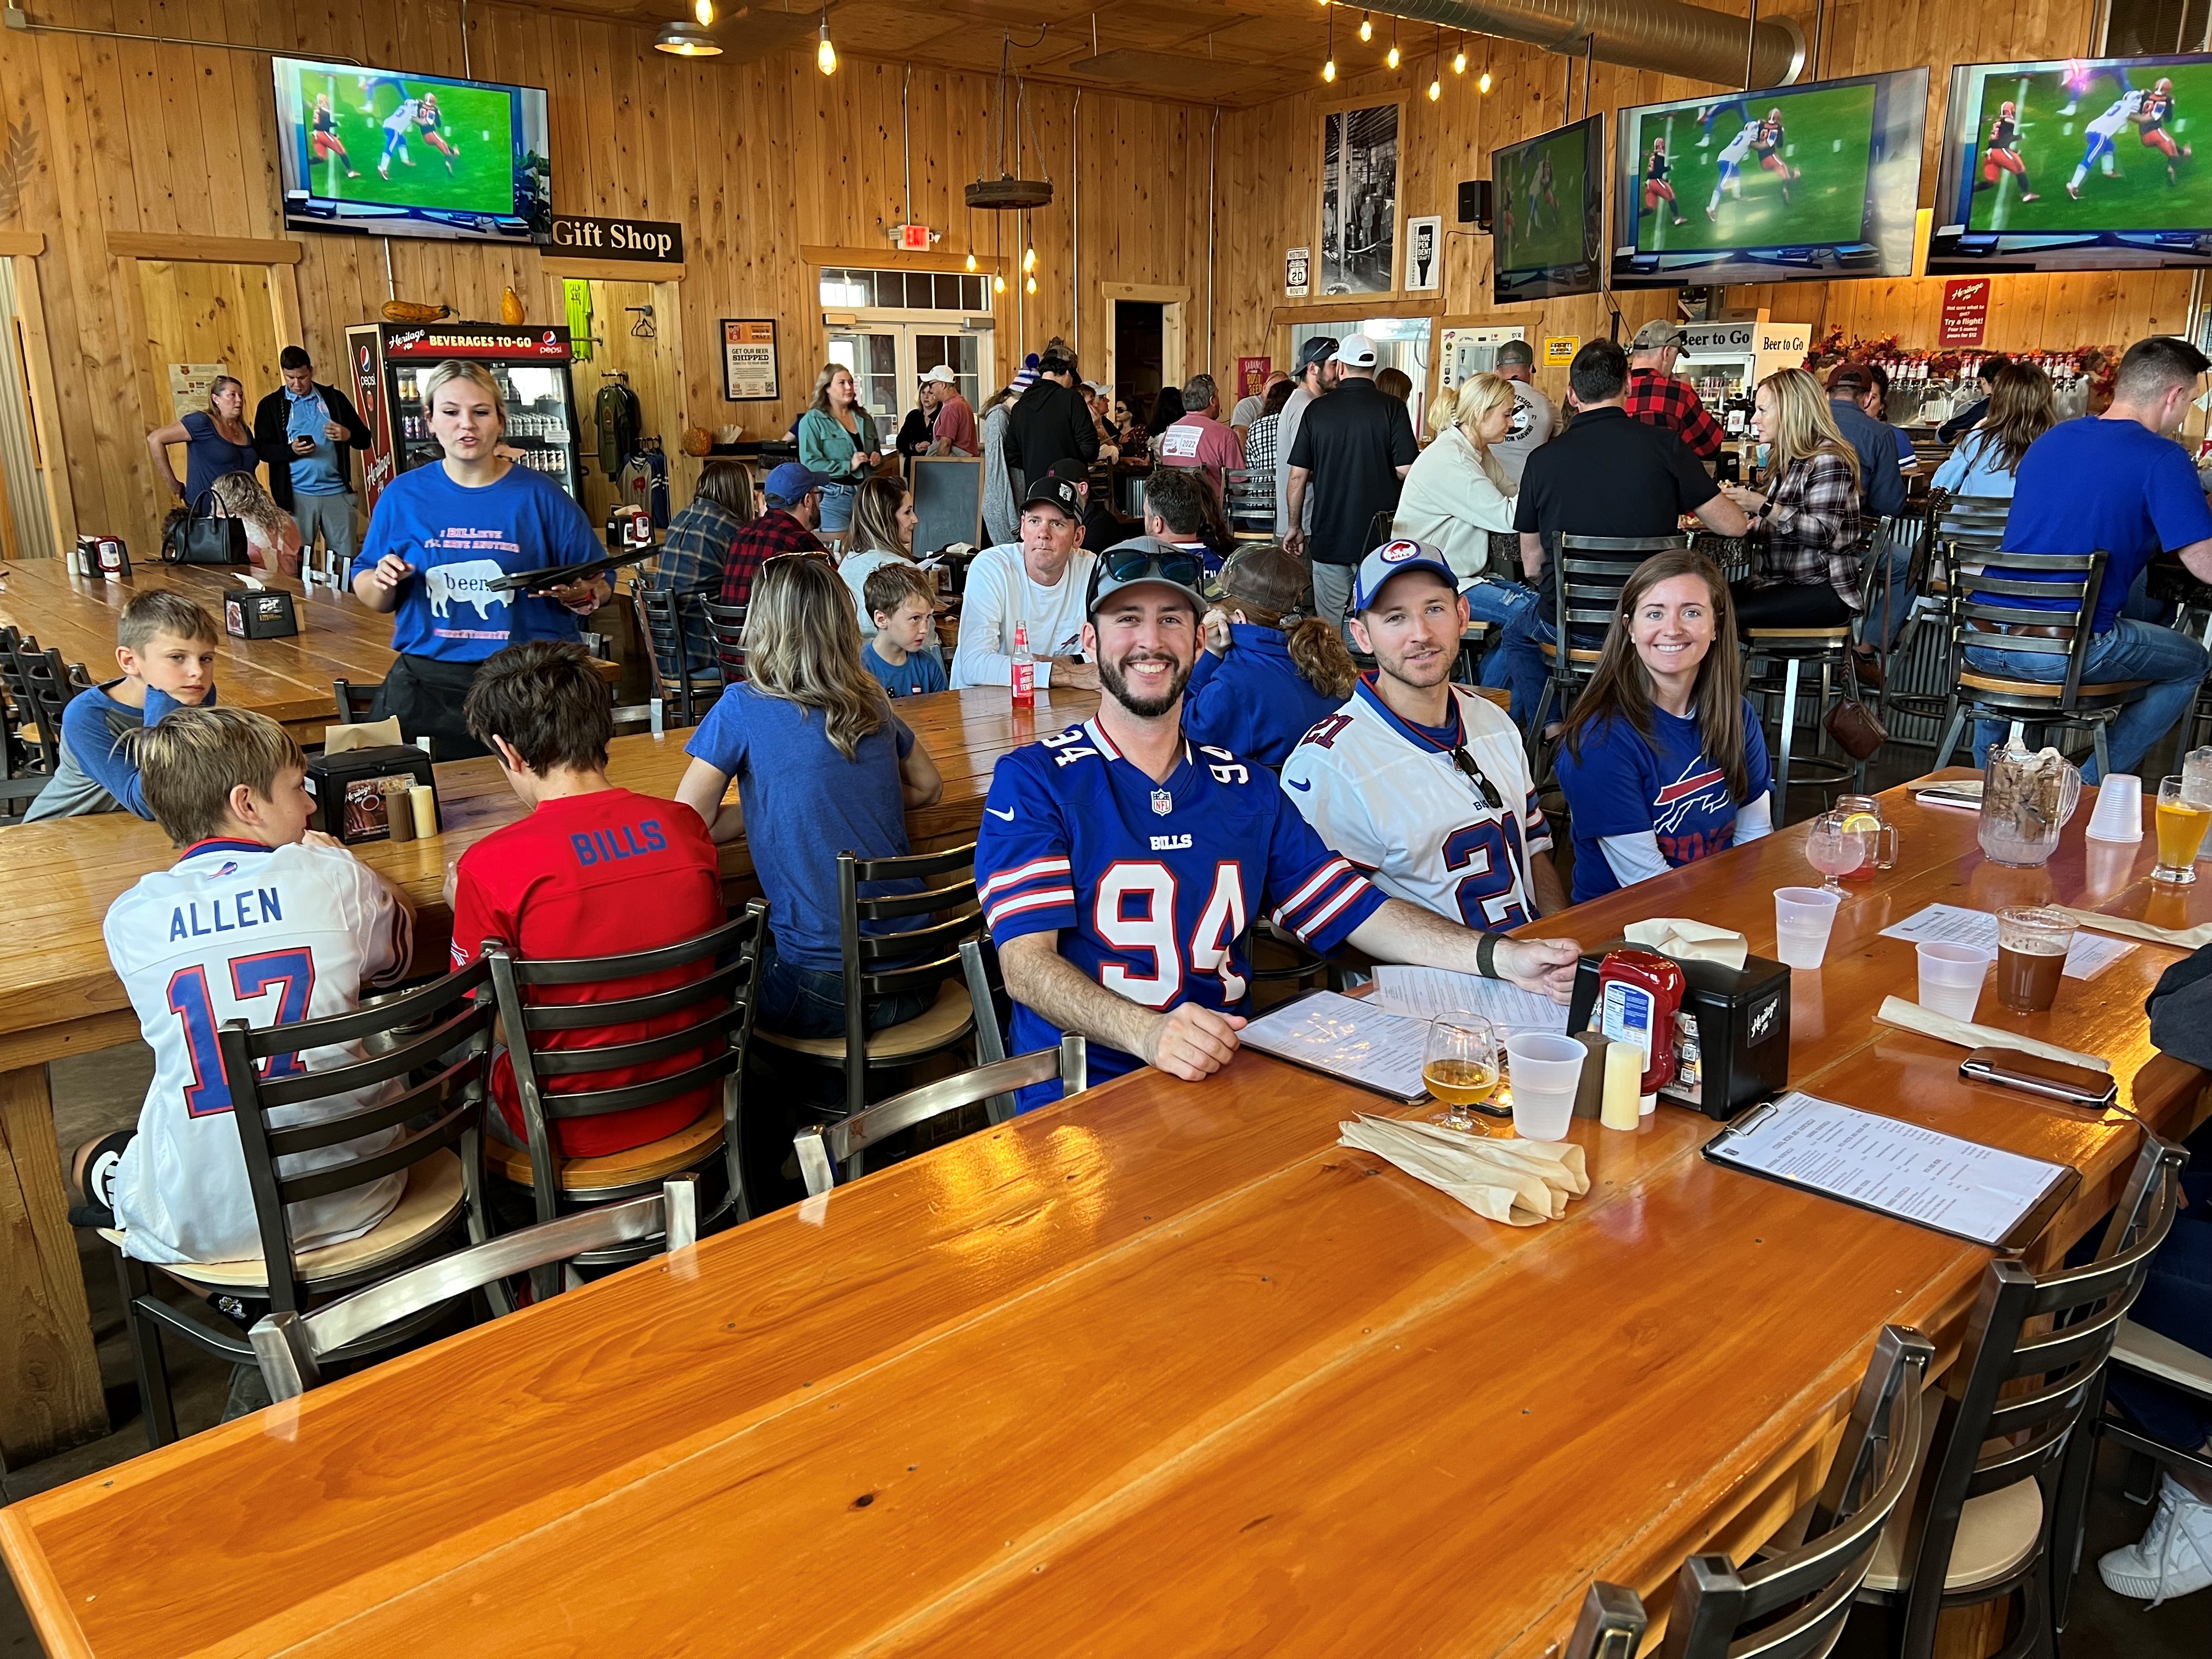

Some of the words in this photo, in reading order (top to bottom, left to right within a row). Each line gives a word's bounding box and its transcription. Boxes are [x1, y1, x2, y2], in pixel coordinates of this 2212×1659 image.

[552, 221, 603, 247] Gift
[610, 224, 672, 258] Shop
[1418, 234, 1431, 242] INDE
[1292, 272, 1302, 281] 20
[1951, 282, 1984, 301] Heritage
[1962, 317, 1983, 326] flight!
[388, 329, 425, 349] Heritage
[429, 335, 494, 347] BEVERAGES
[496, 336, 532, 348] TO-GO
[1713, 332, 1725, 345] to
[1730, 330, 1750, 344] Go
[1763, 337, 1781, 350] Beer
[1783, 338, 1790, 350] to
[1792, 337, 1803, 351] Go
[540, 346, 562, 354] pepsi
[360, 373, 376, 388] pepsi
[1182, 439, 1196, 448] 2022
[367, 452, 391, 492] Heritage
[1300, 713, 1355, 749] 21
[1155, 800, 1170, 811] NFL
[569, 819, 668, 867] BILLS
[1149, 834, 1193, 850] BILLS
[170, 887, 282, 942] ALLEN
[1093, 859, 1248, 1011] 94
[1751, 998, 1778, 1037] Heritage
[166, 946, 315, 1119] 17
